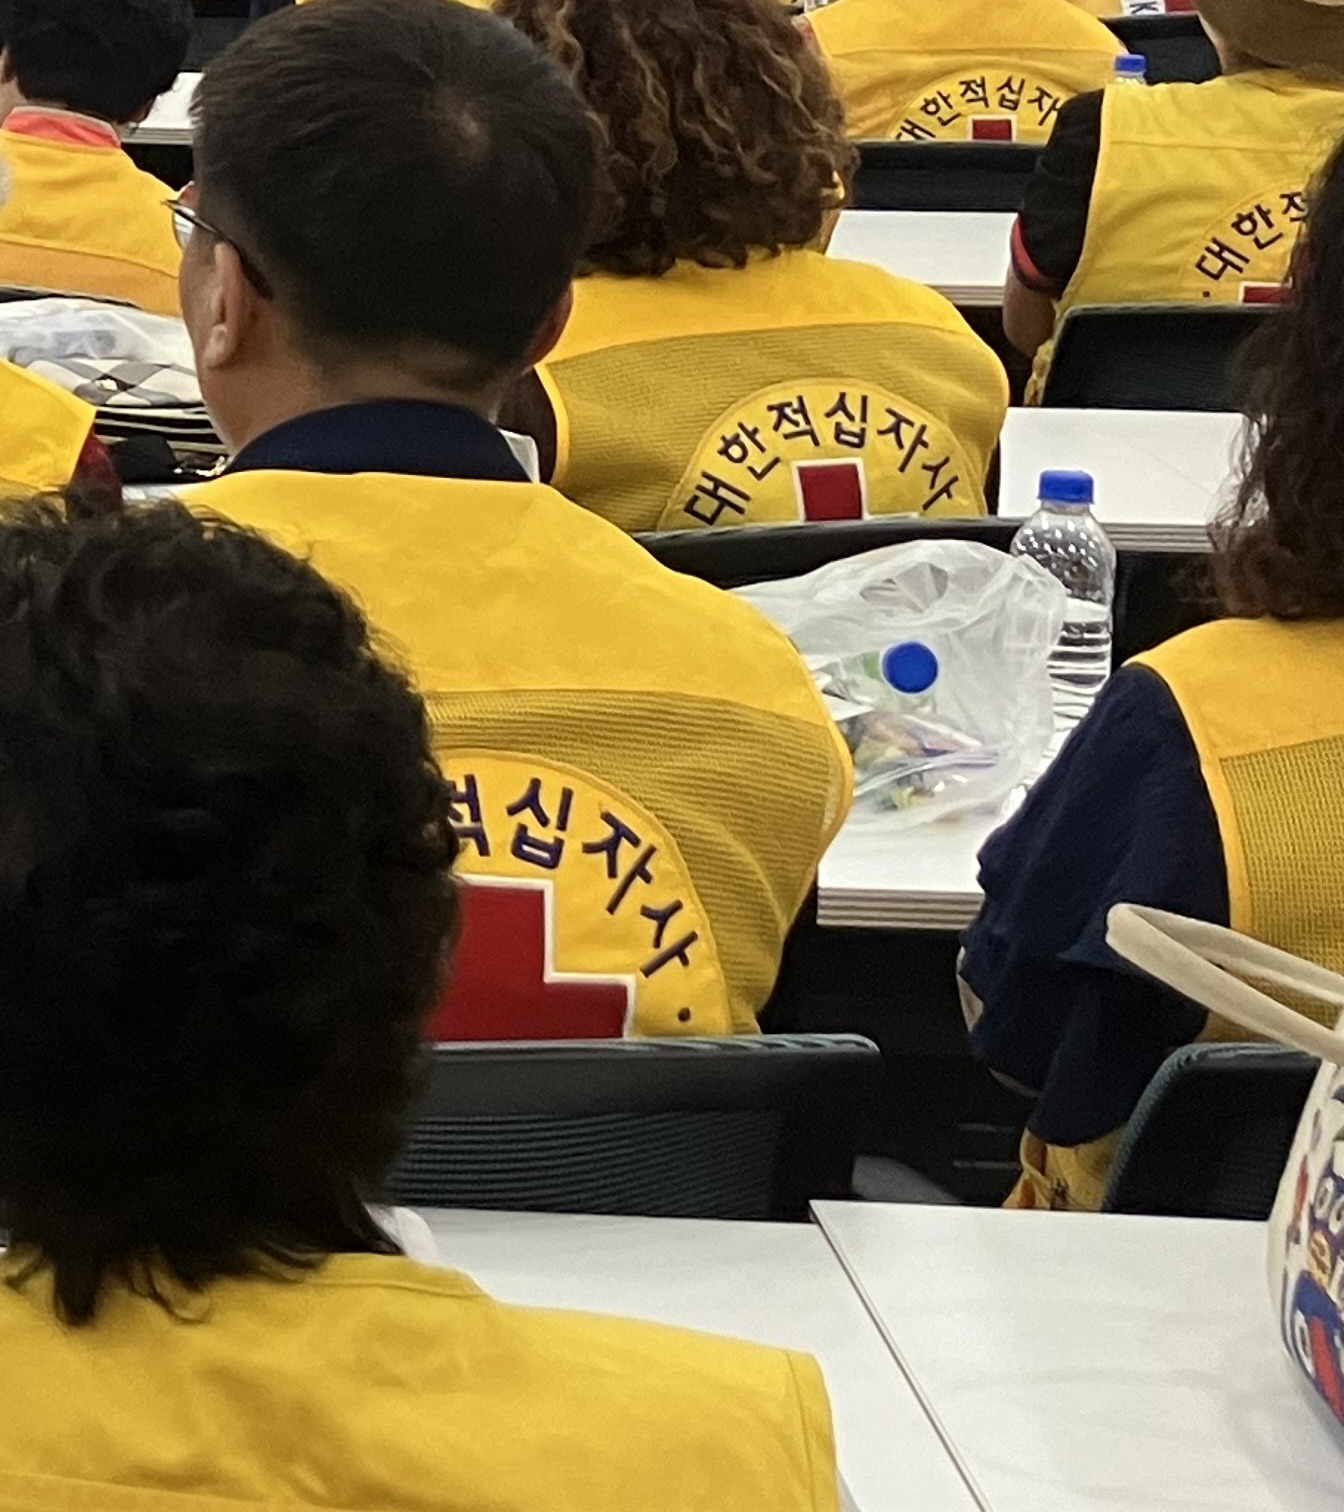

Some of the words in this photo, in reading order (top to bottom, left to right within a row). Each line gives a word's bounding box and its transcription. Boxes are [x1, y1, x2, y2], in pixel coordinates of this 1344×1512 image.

[896, 75, 1062, 141] 대한적십자
[683, 392, 960, 526] 대한적십자사
[446, 774, 699, 978] 적십자사
